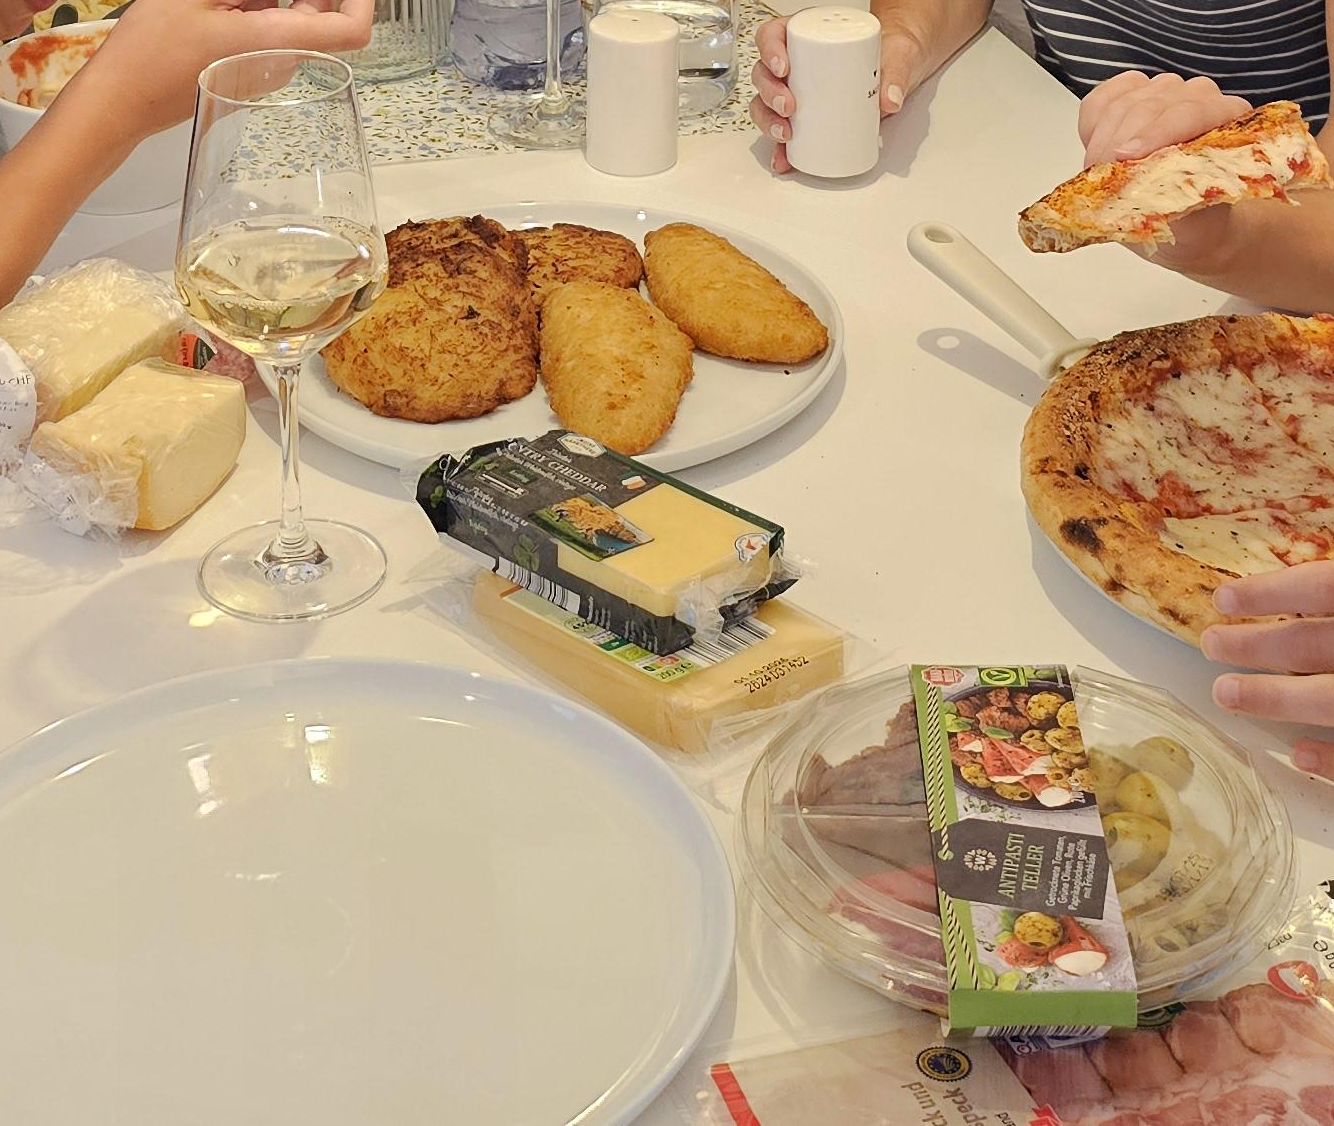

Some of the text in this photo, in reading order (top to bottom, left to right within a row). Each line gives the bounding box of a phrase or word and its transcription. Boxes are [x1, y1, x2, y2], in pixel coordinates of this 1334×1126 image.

[548, 461, 607, 493] CHEDDAR
[997, 833, 1025, 899] ANTIPASTI
[1021, 845, 1045, 891] TELLER
[1045, 865, 1061, 907] Getrocknete
[1057, 882, 1069, 904] Grüne
[900, 1081, 936, 1110] und
